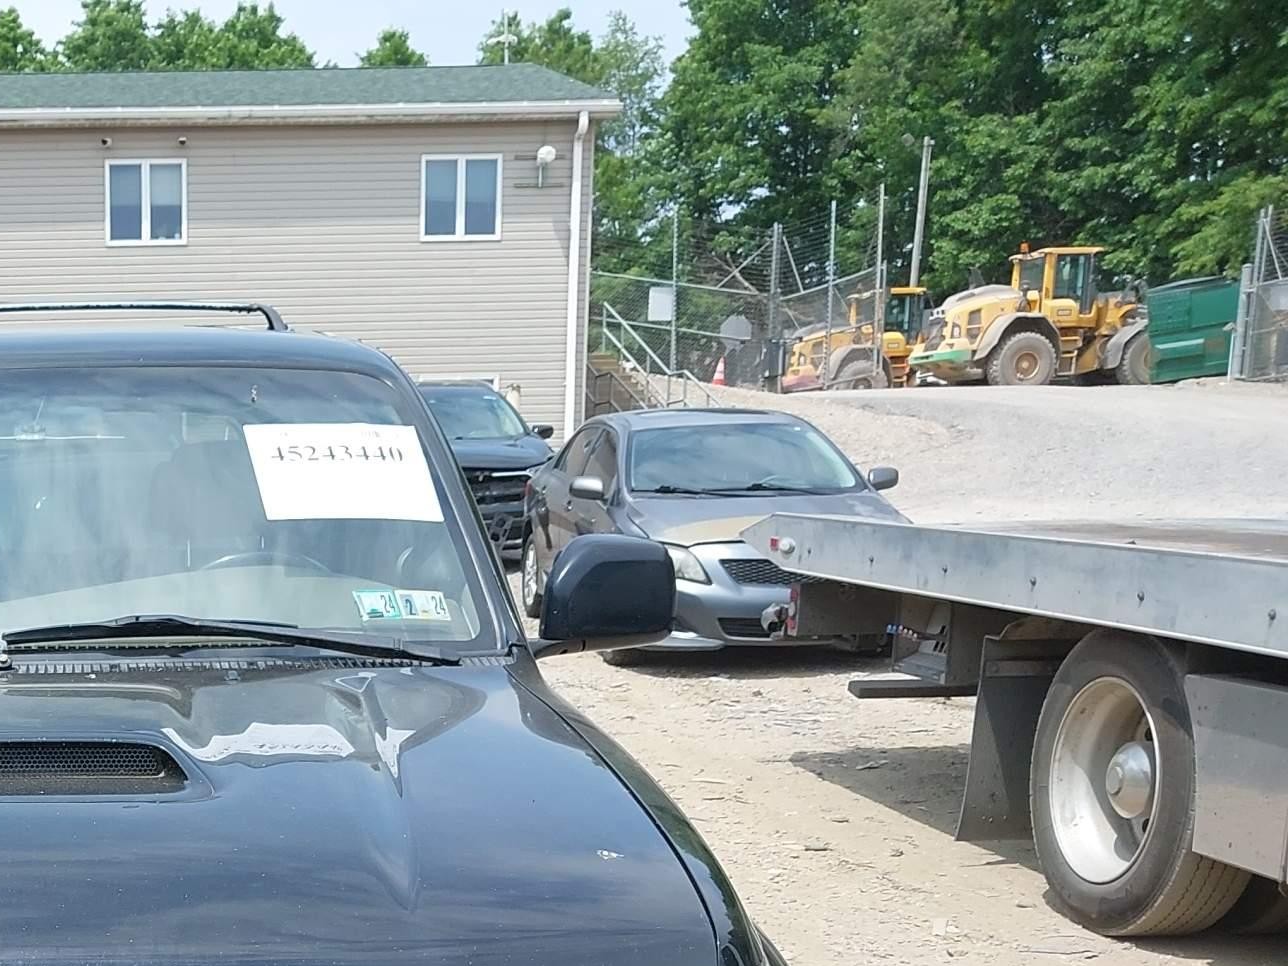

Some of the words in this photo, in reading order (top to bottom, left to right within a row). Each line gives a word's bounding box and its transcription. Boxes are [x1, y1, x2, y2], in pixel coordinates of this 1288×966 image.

[271, 445, 403, 461] 45243440
[380, 594, 396, 613] 24
[431, 595, 447, 615] 24
